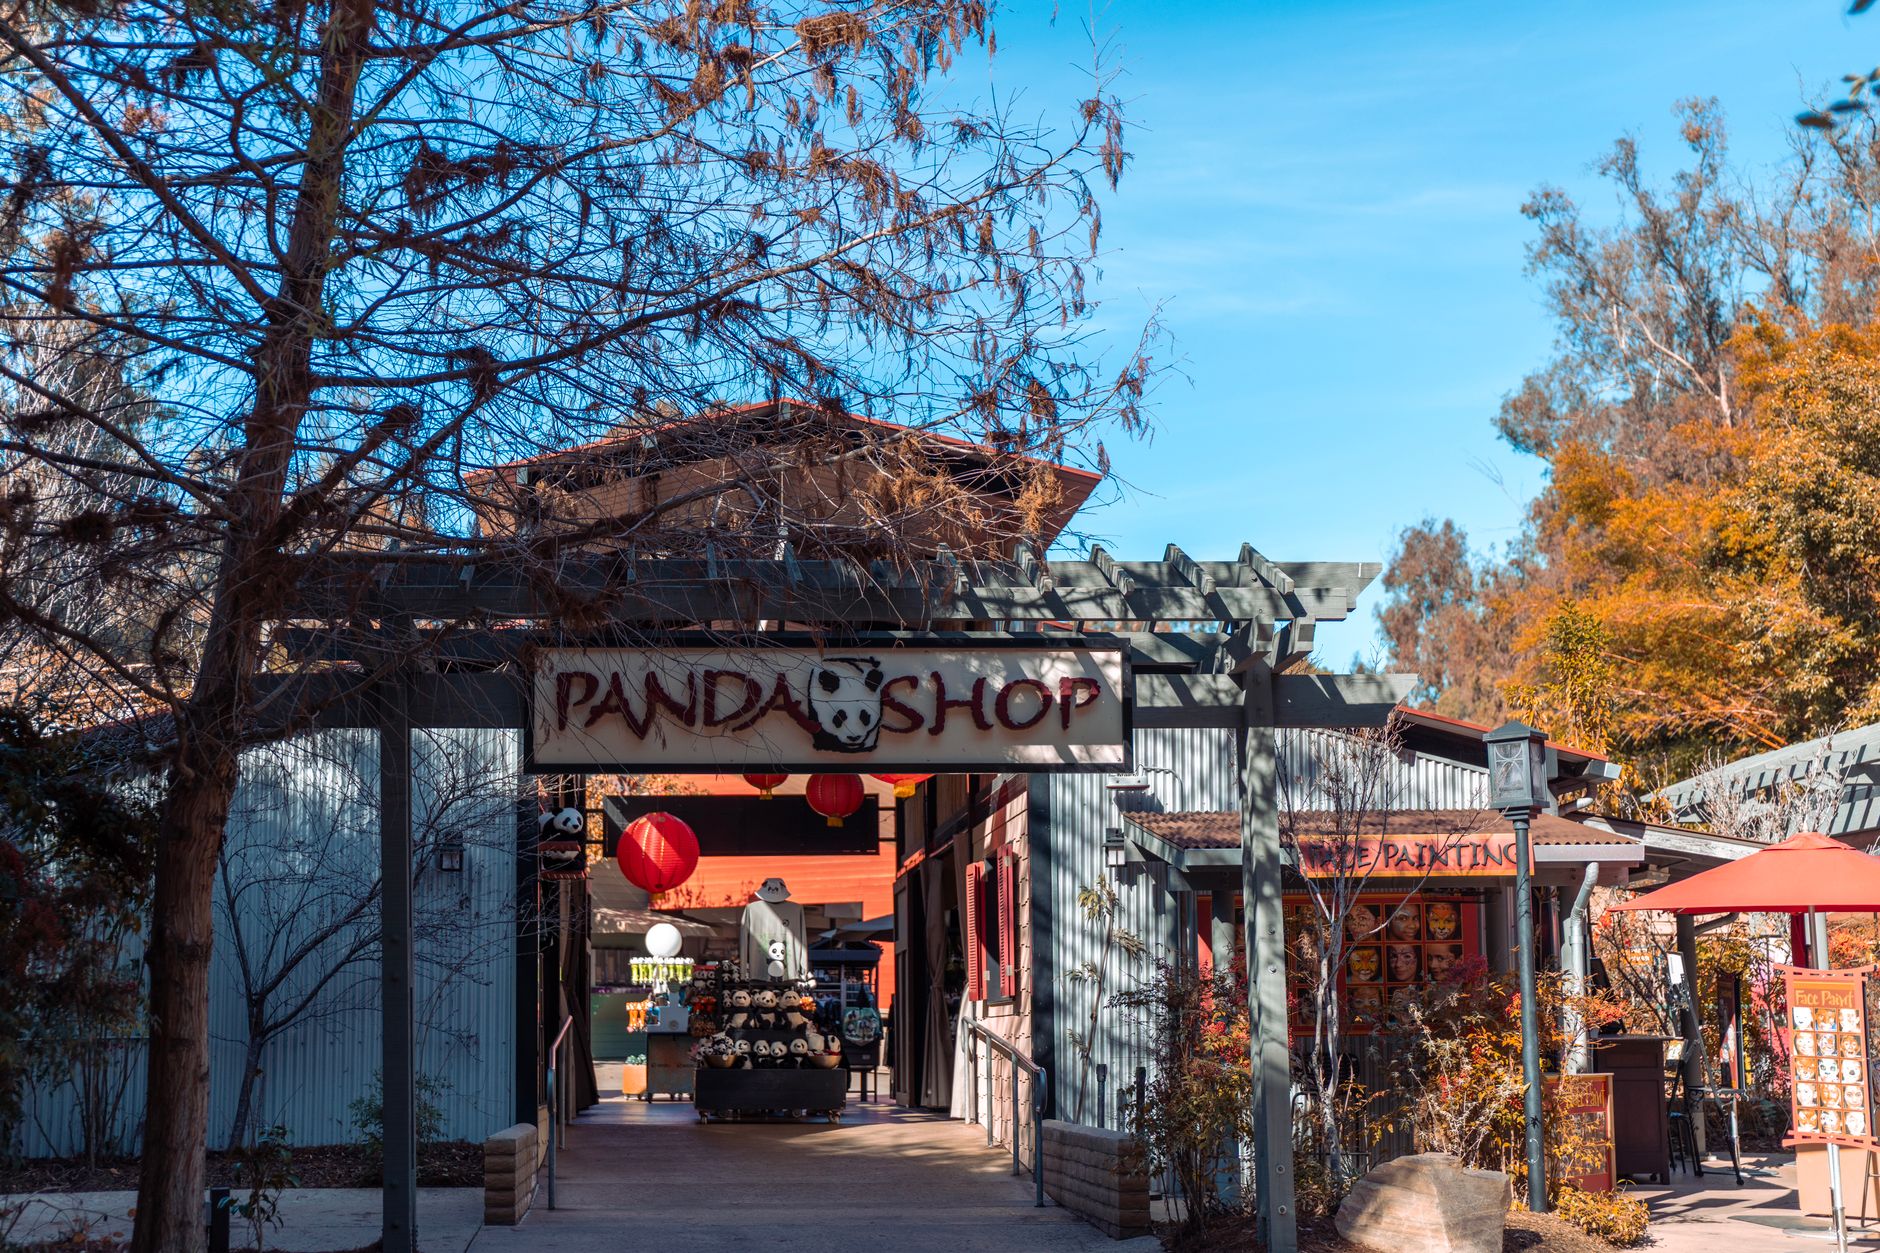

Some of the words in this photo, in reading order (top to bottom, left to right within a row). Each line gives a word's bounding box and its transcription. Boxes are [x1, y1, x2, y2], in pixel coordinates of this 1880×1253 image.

[556, 670, 822, 740] PANDA
[880, 671, 1101, 736] SHOP
[1795, 989, 1819, 1006] Face
[1821, 990, 1854, 1008] Paint
